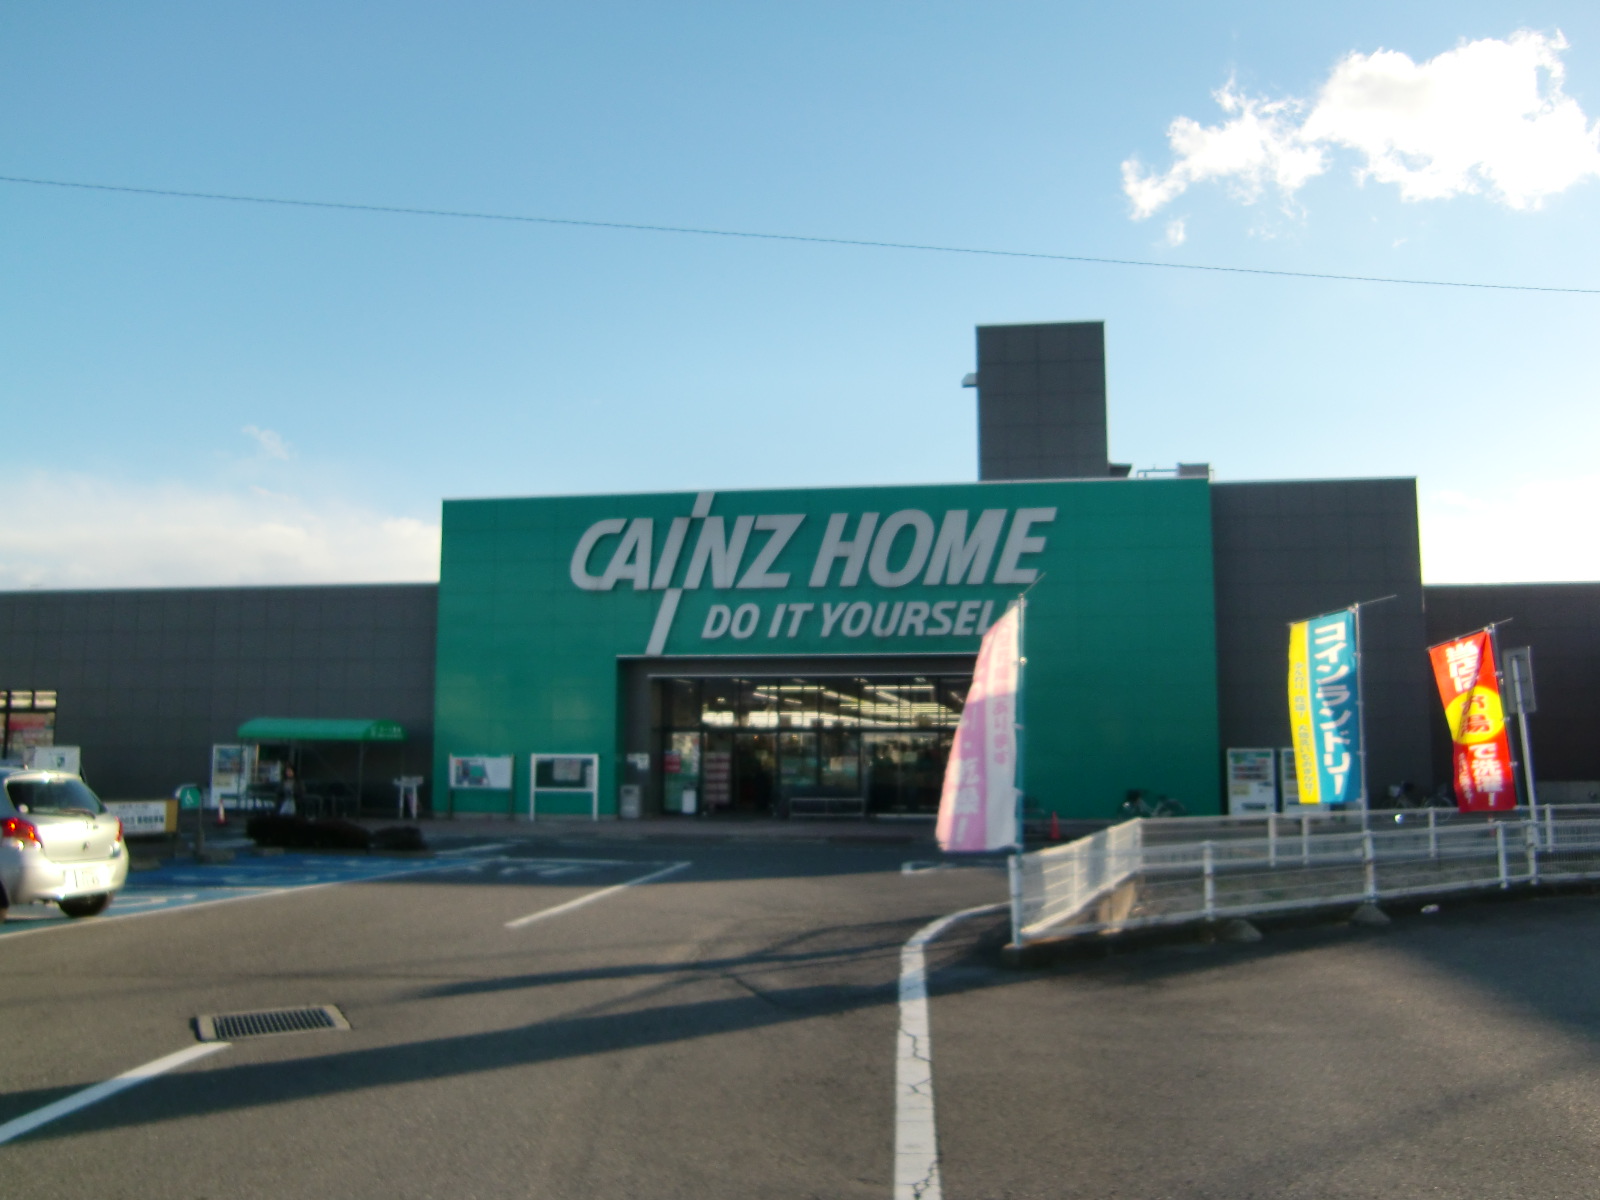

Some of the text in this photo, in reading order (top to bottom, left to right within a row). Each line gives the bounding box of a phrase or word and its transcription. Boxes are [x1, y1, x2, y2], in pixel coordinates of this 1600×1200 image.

[569, 506, 1058, 591] CAINZ HOME
[701, 601, 759, 639] DO
[767, 602, 814, 639] IT
[1314, 621, 1352, 796] コインランドリー
